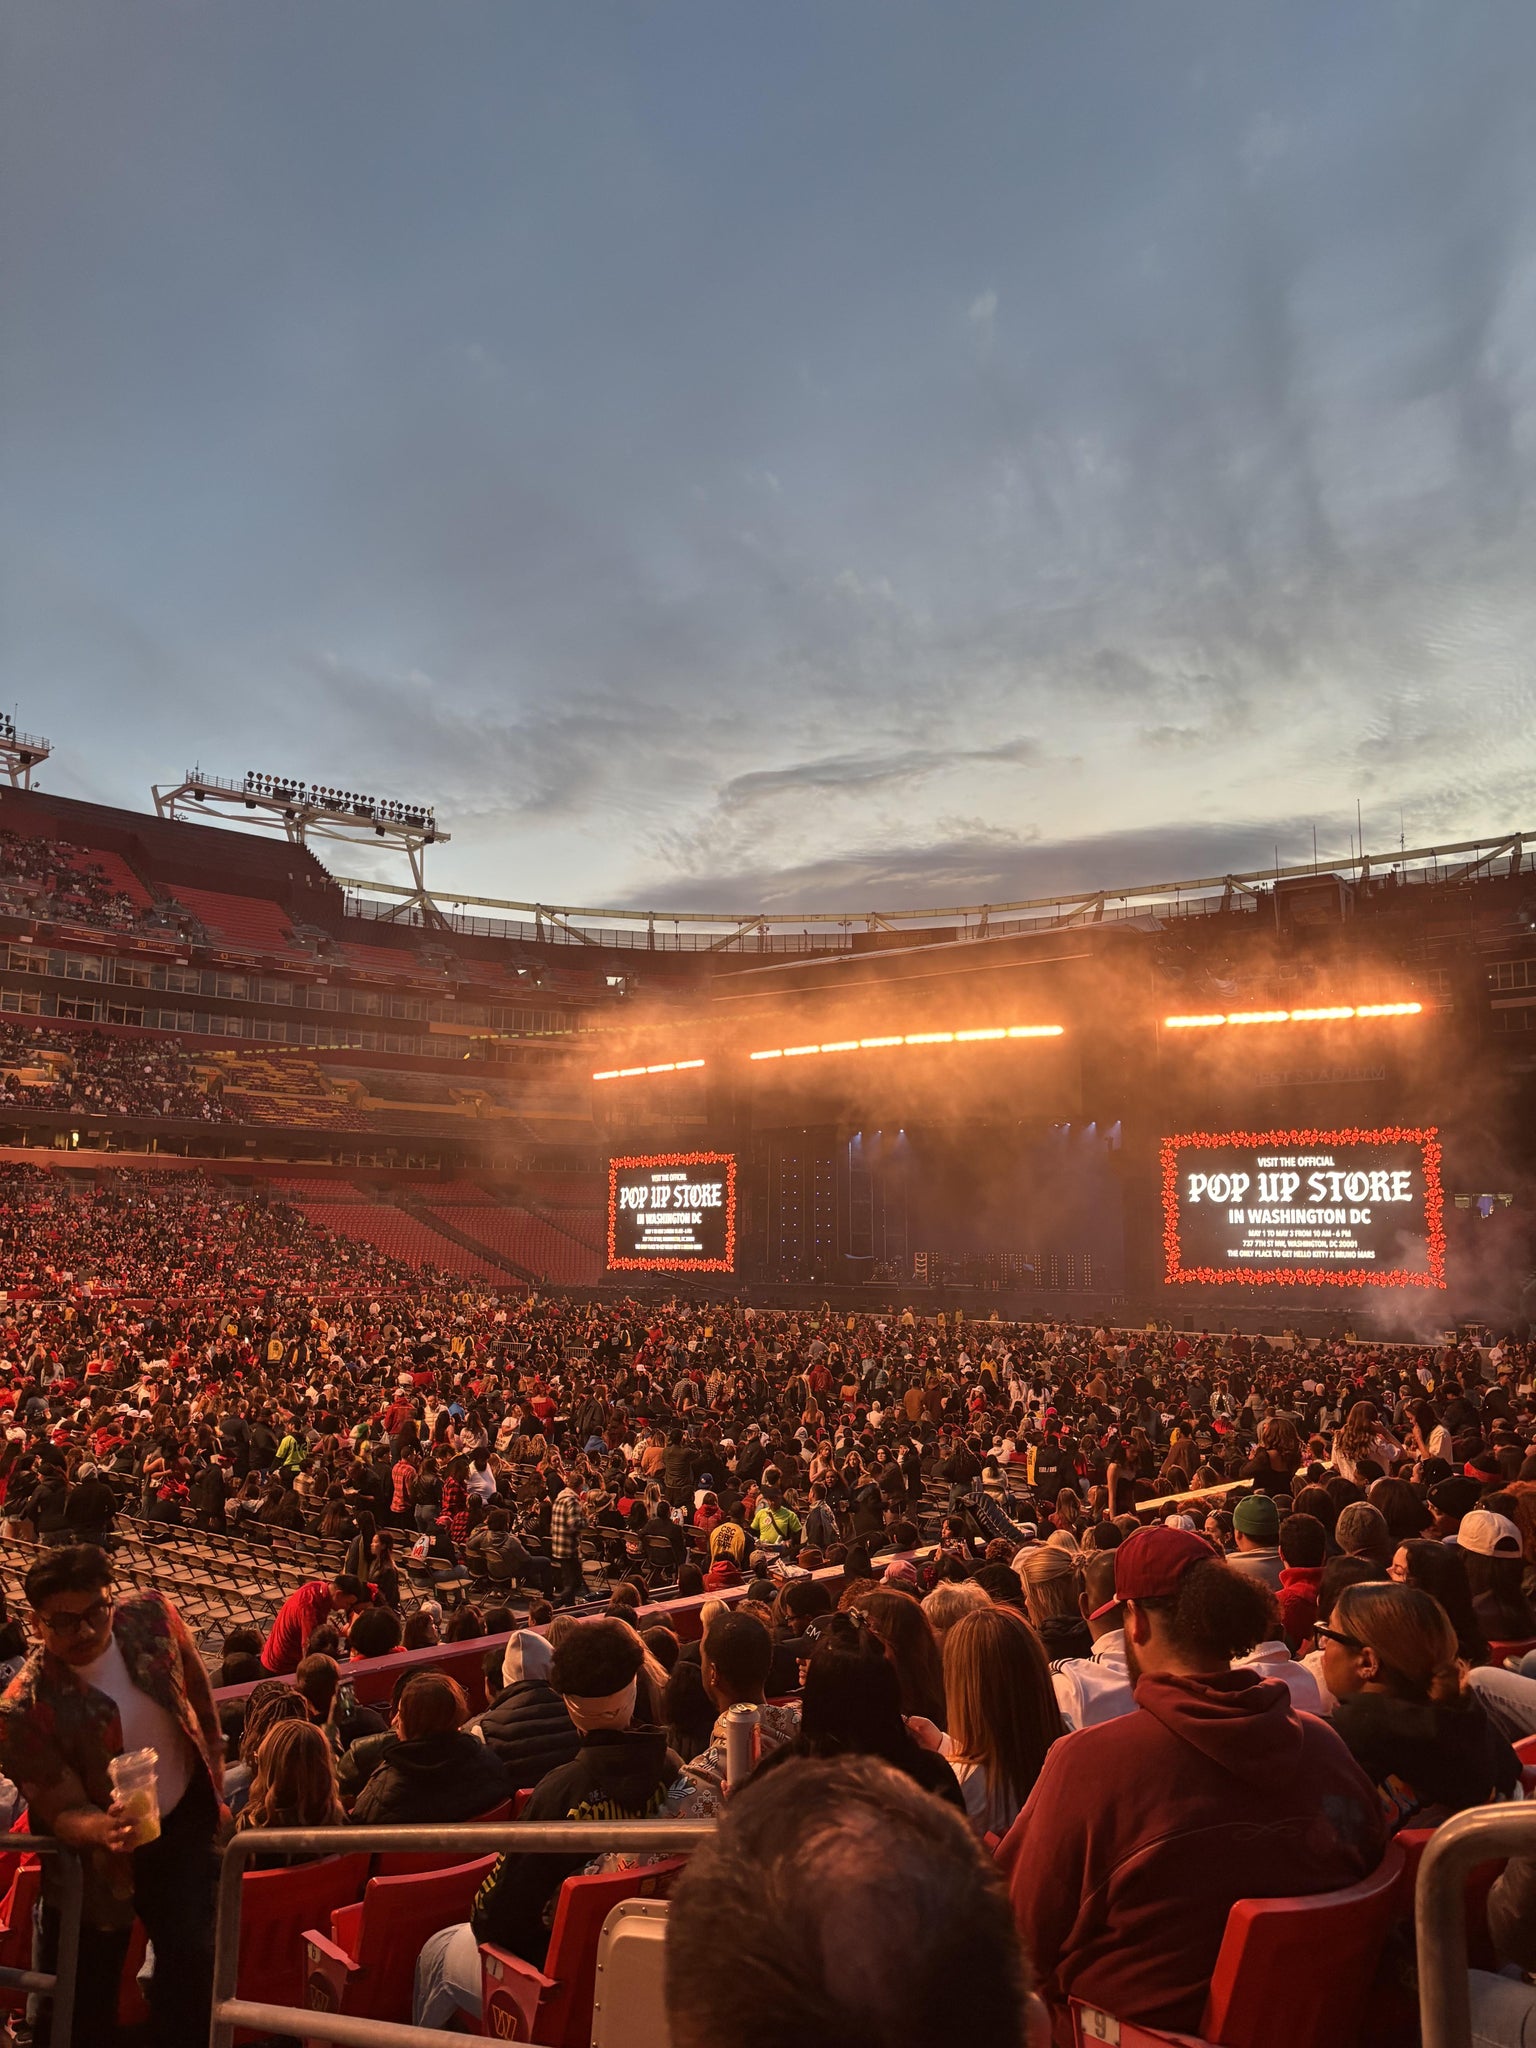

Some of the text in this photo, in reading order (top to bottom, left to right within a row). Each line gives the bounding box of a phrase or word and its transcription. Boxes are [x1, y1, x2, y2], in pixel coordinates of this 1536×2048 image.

[1257, 1156, 1335, 1167] VISIT THE OFFICIAL
[1187, 1170, 1413, 1203] POP UP STORE
[619, 1183, 722, 1209] POP UP STORE
[646, 1213, 690, 1224] WASHINGTON
[692, 1212, 703, 1224] DC
[1228, 1208, 1372, 1224] IN WASHINGTON DC
[1248, 1229, 1261, 1238] MAY
[1267, 1229, 1275, 1238] TO
[1276, 1229, 1288, 1238] MAY
[1313, 1229, 1320, 1238] 10
[1321, 1229, 1331, 1238] AM
[1341, 1229, 1351, 1238] PM
[1329, 1240, 1338, 1248] DC
[1227, 1250, 1239, 1258] THE
[1273, 1250, 1280, 1258] TO
[720, 1525, 736, 1536] CSC
[1094, 2011, 1106, 2039] 9
